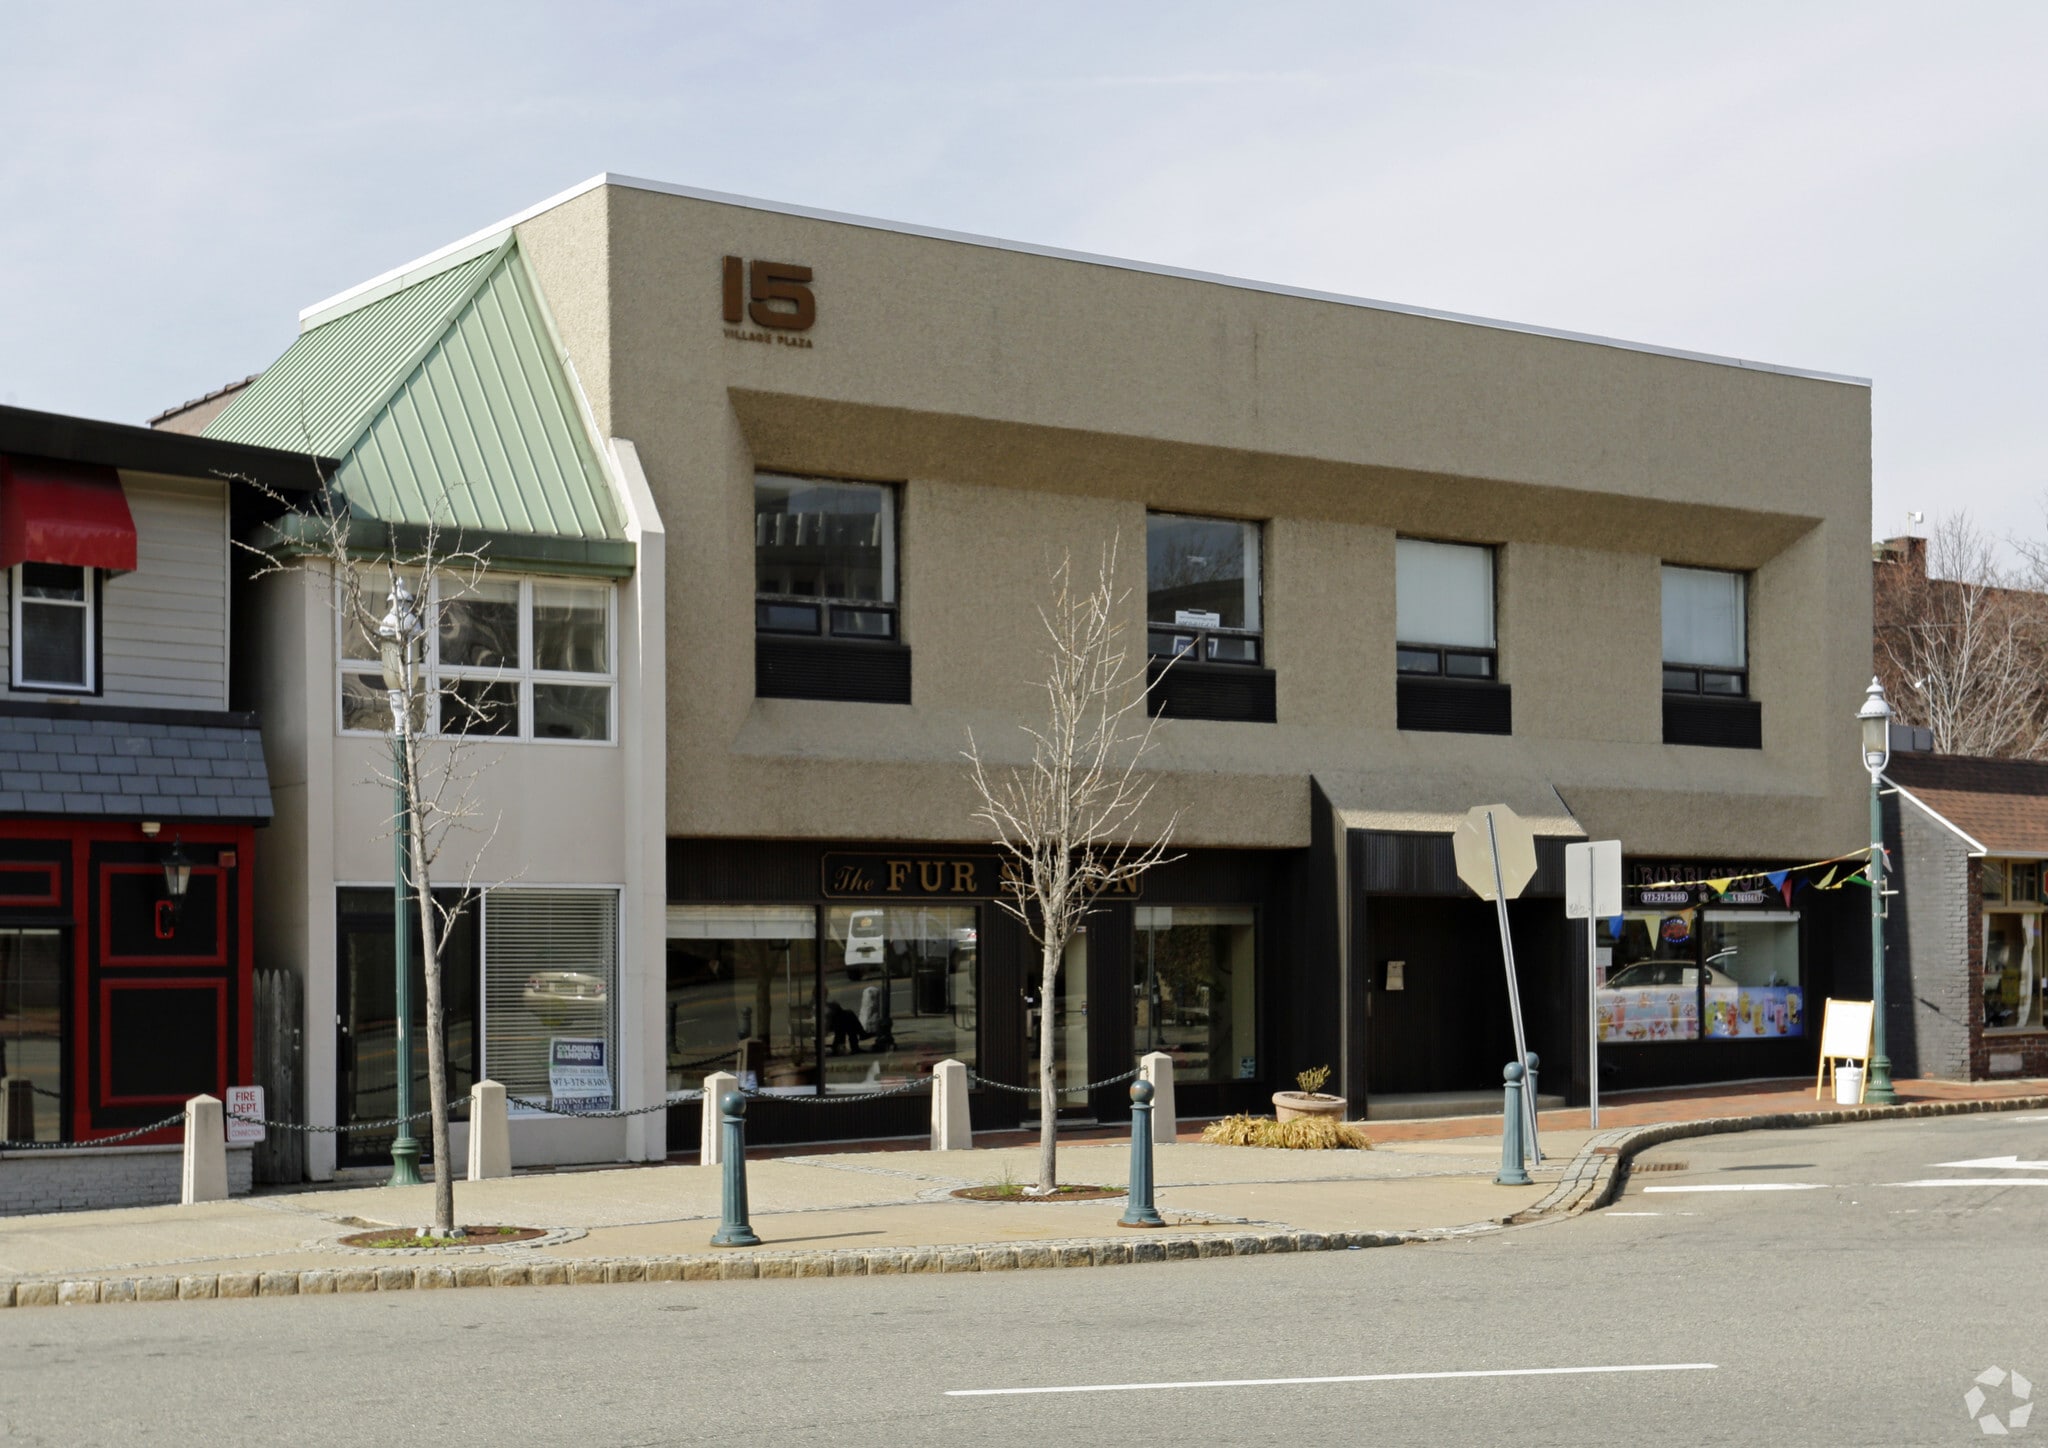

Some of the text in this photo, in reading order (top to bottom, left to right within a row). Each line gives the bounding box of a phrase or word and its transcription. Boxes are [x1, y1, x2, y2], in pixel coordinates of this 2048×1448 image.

[722, 255, 816, 332] 15
[723, 328, 813, 349] VILLAGE PLAZA
[833, 861, 1137, 893] The FUR SON
[235, 1091, 256, 1102] FIRE
